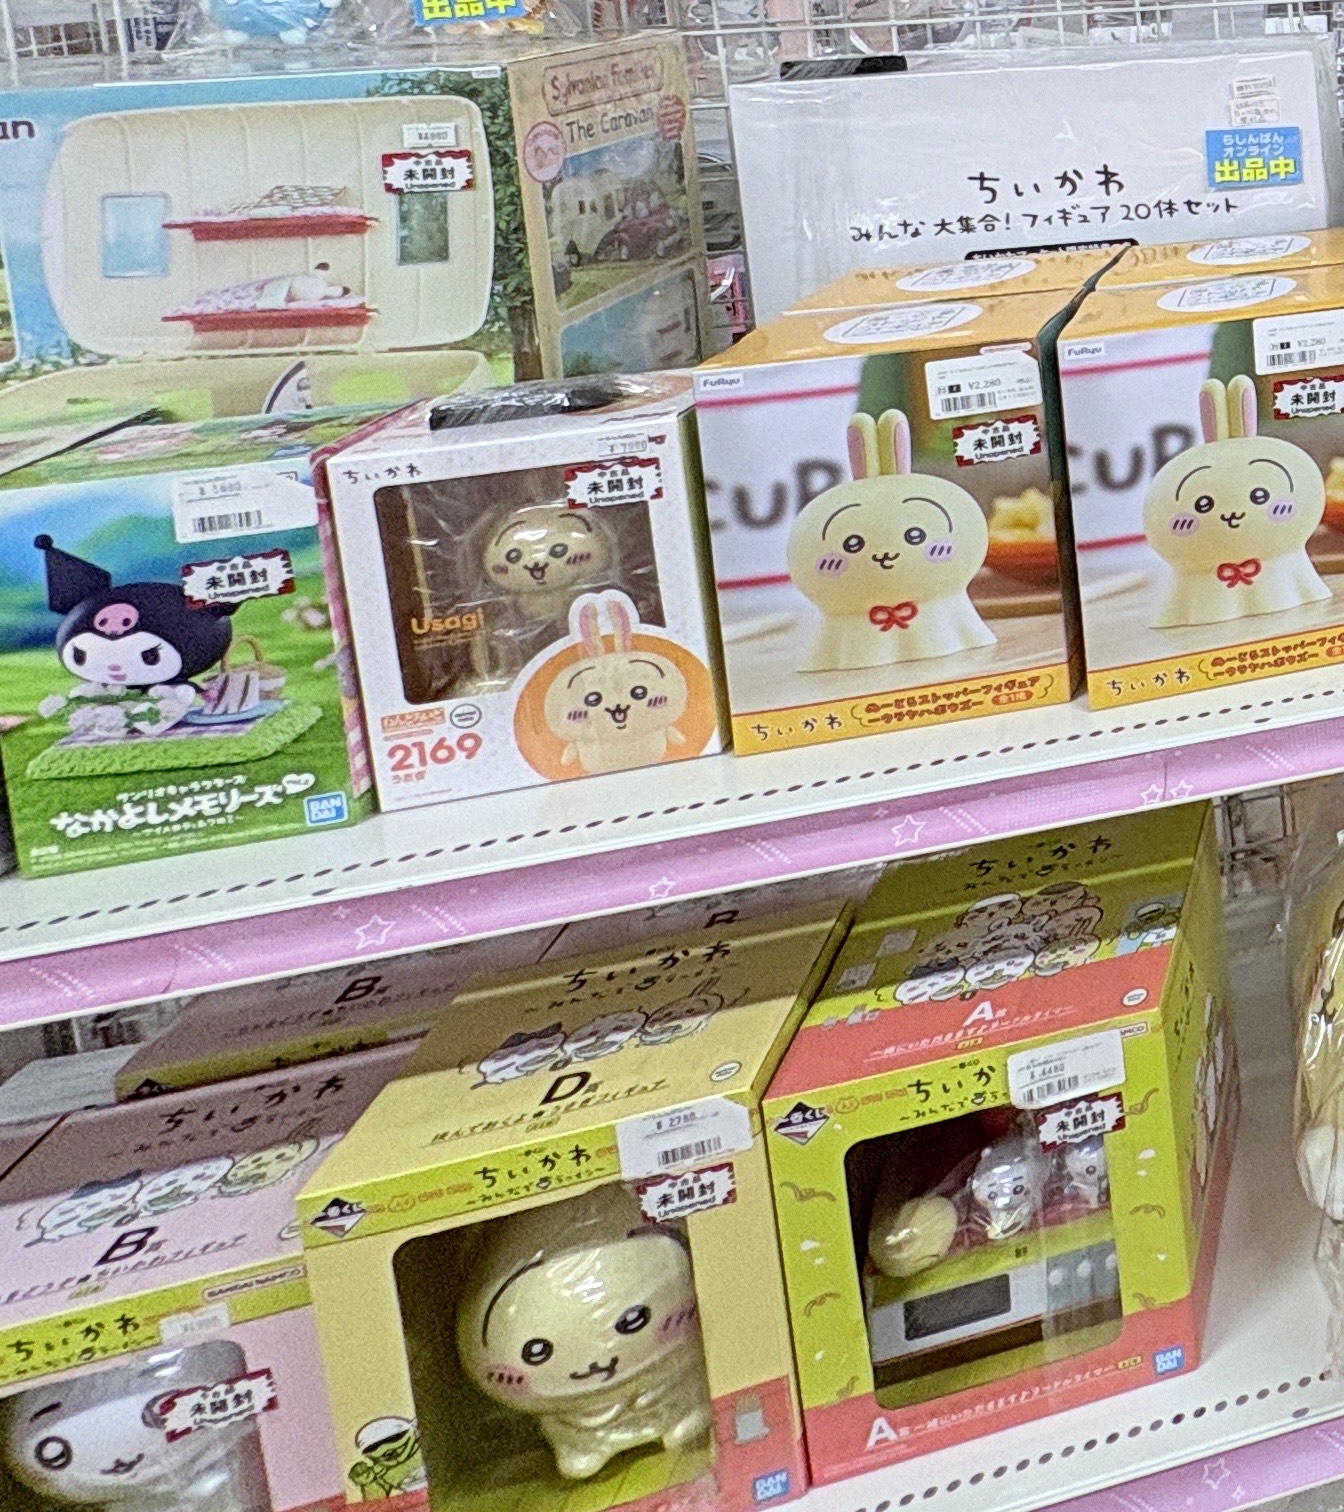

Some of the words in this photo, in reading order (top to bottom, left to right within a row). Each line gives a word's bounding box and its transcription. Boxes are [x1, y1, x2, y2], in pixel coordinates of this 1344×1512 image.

[566, 118, 595, 143] The
[601, 105, 654, 134] Caravan
[1223, 132, 1284, 146] らしんばん
[1223, 144, 1284, 158] オンライン
[967, 164, 1126, 204] ちいかわ
[1215, 156, 1296, 184] 出品中
[1289, 390, 1337, 407] 未開封
[1290, 403, 1337, 415] Unopened
[972, 432, 1024, 452] 未開封
[974, 445, 1025, 461] Unopened
[343, 462, 421, 485] ちいかわ
[587, 476, 644, 495] 未開封
[588, 491, 645, 504] Unopened
[411, 607, 485, 635] Usagi
[1106, 668, 1191, 696] ちいかわ
[751, 713, 843, 742] ちいかわ
[387, 733, 483, 772] 2169
[50, 784, 283, 838] なかよしメモリーズ
[309, 797, 342, 812] BAN
[969, 834, 1112, 877] ちいかわ
[563, 939, 732, 994] ちいかわ
[156, 1074, 346, 1136] ちいかわ
[1056, 1112, 1106, 1133] 未開封
[474, 1144, 592, 1189] ちいかわ
[656, 1180, 715, 1209] 未開封
[6, 1313, 141, 1363] ちいかわ
